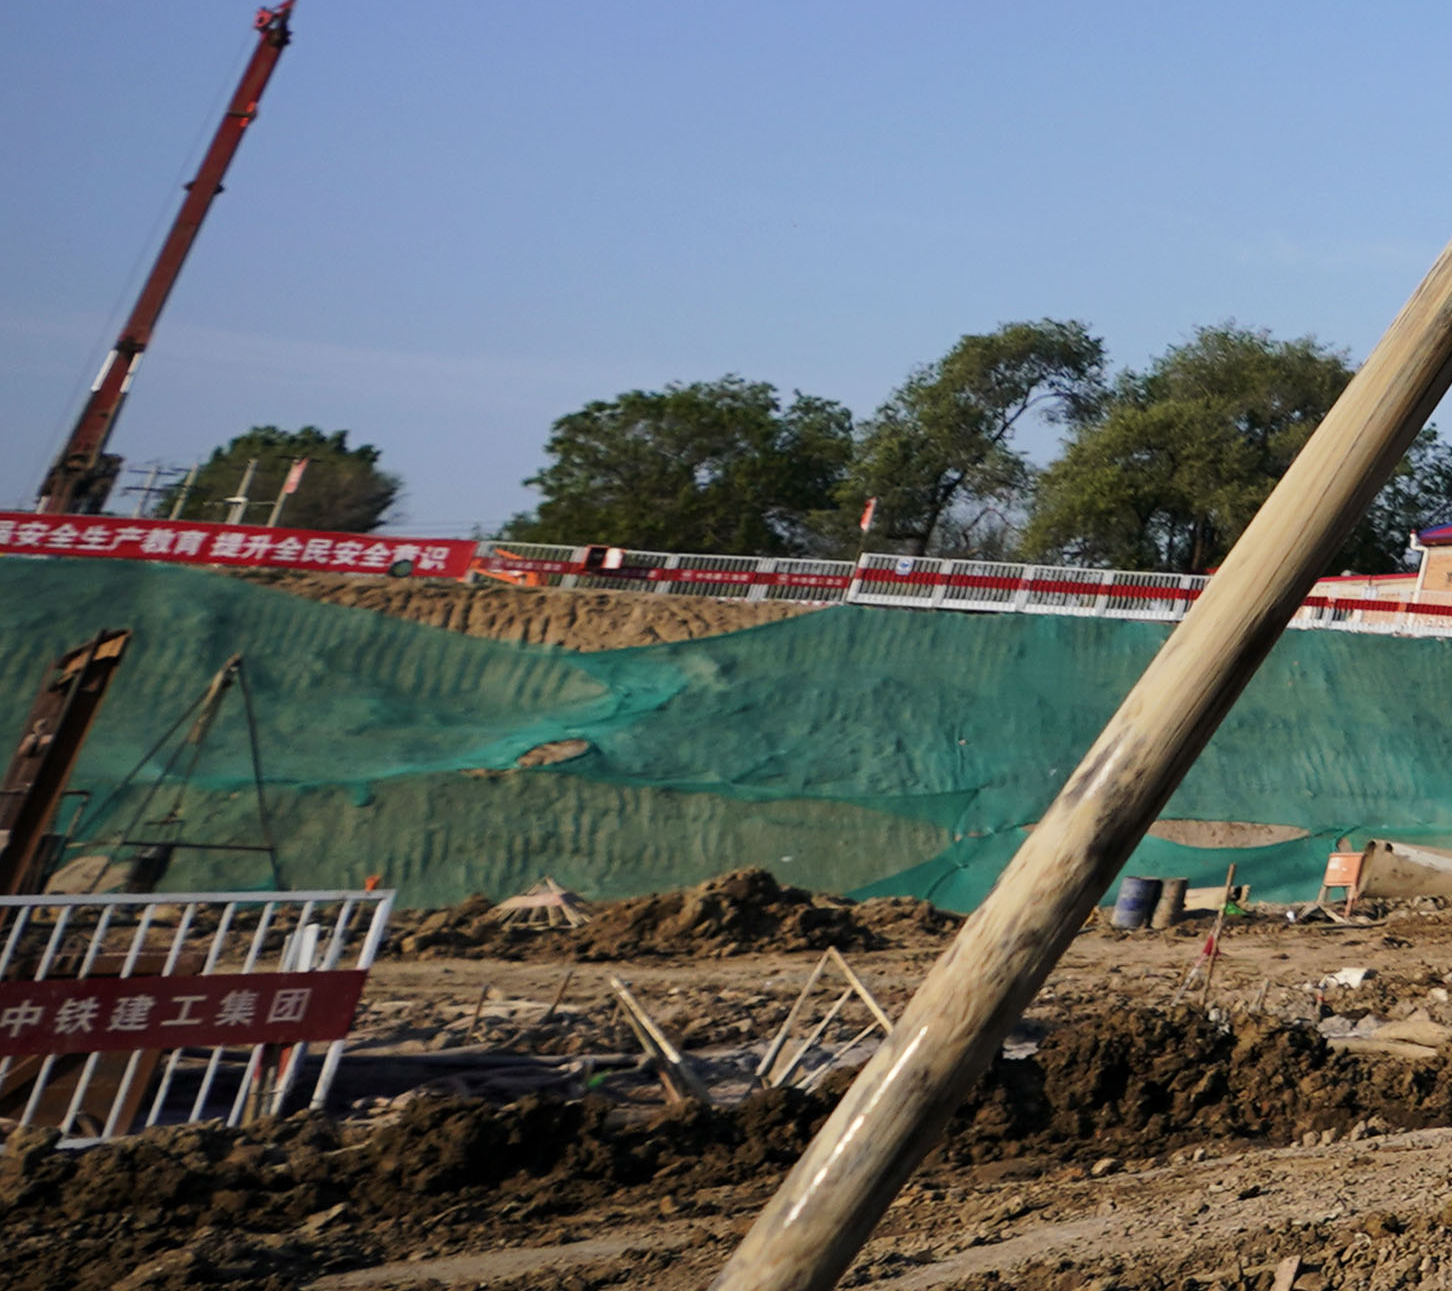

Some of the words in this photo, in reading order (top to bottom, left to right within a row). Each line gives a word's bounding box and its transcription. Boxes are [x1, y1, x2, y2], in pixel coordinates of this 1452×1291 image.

[0, 987, 313, 1038] 中铁建工集团
